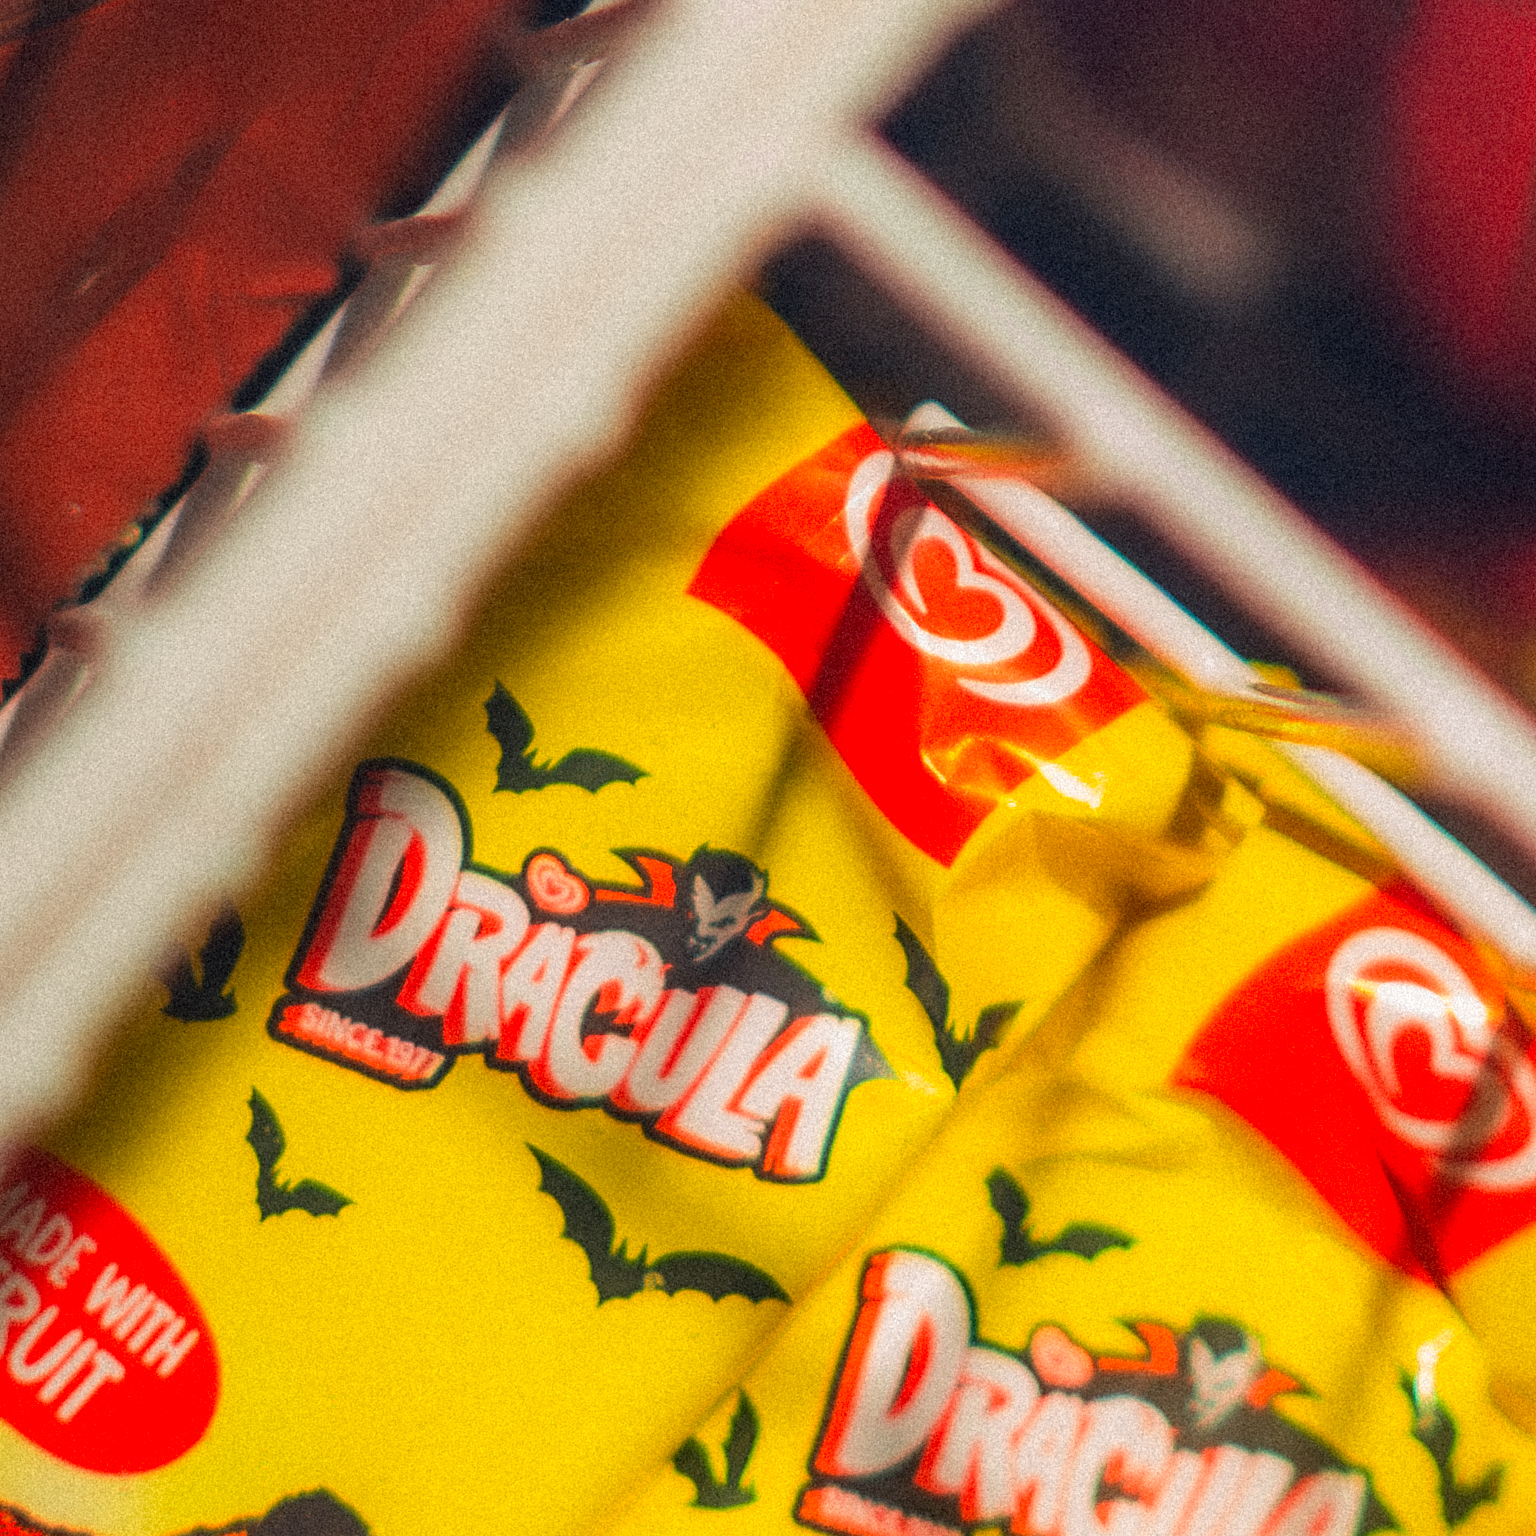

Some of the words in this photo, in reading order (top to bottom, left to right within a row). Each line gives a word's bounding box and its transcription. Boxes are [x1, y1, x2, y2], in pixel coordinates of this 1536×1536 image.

[297, 765, 864, 1181] DRACULA
[295, 999, 386, 1064] SINCE
[84, 1262, 200, 1378] WITH
